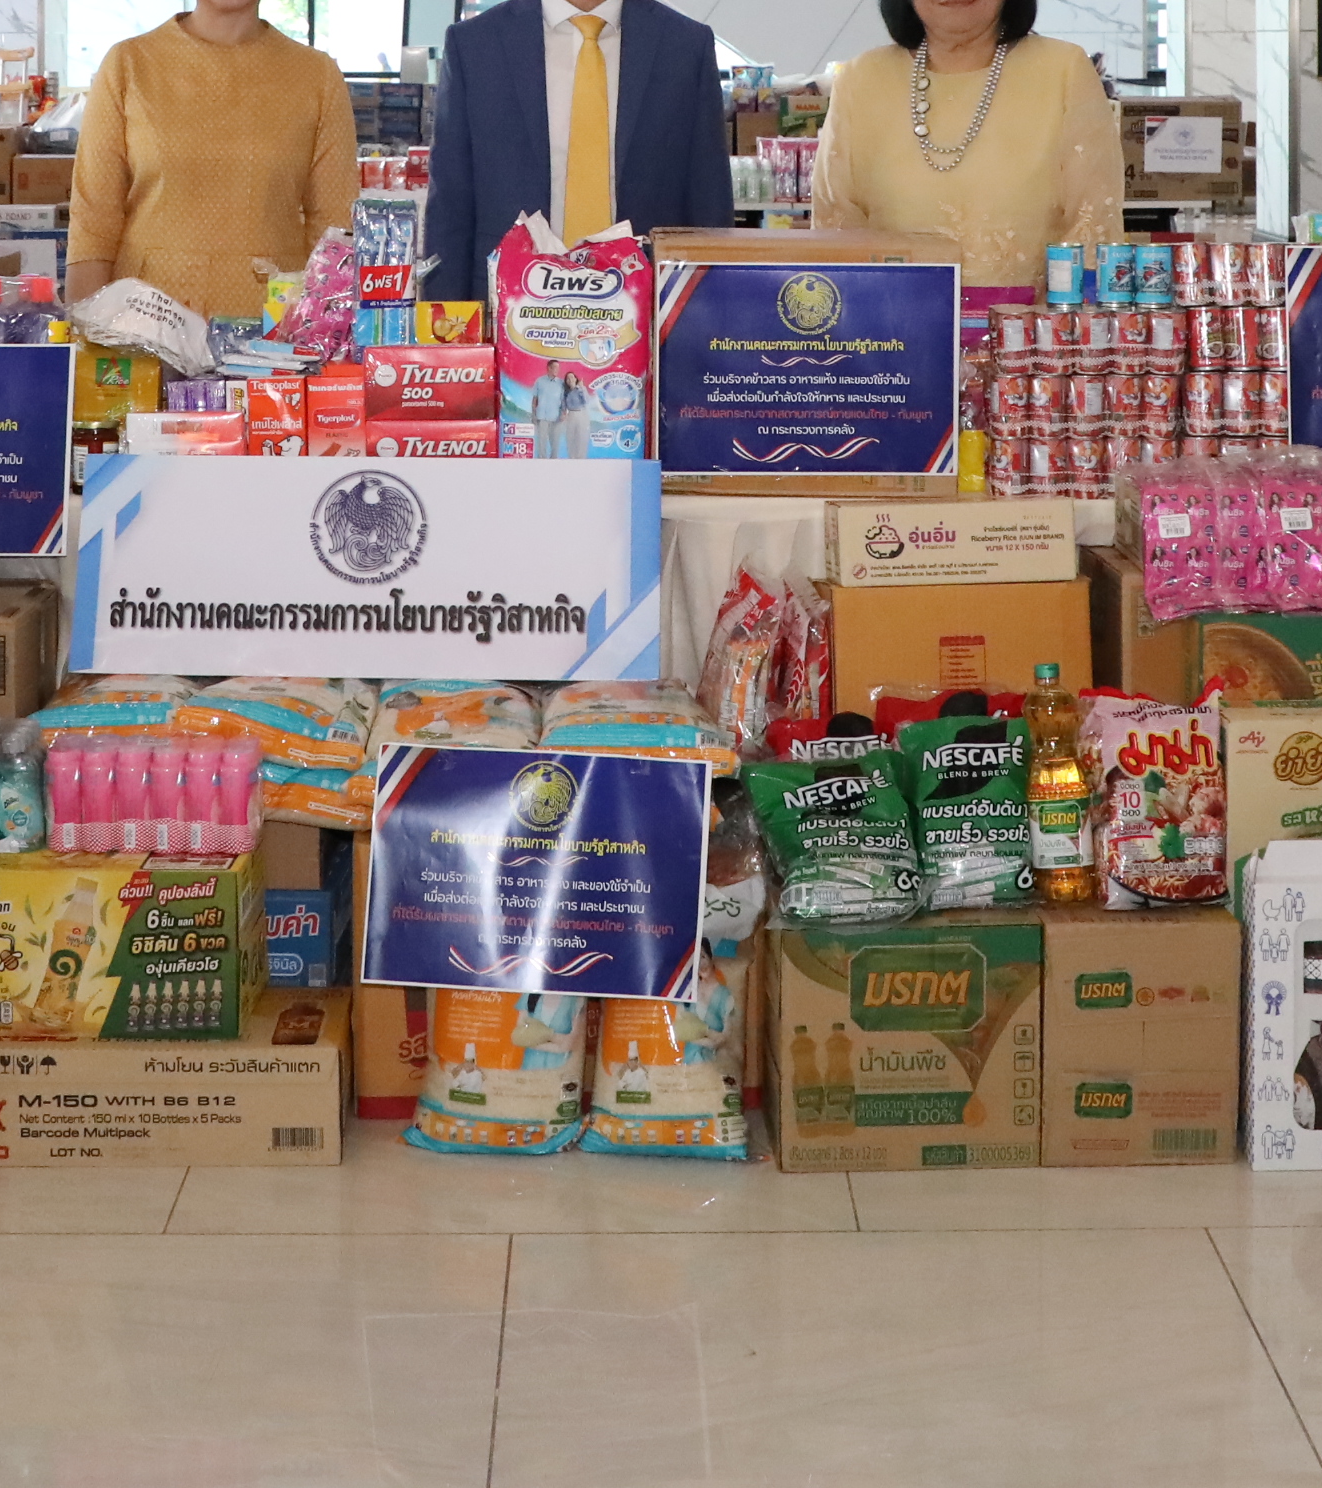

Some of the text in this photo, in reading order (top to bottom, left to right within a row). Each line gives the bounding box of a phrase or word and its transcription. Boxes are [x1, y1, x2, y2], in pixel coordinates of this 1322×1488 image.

[151, 291, 173, 307] Thai
[709, 335, 905, 354] สำนักงานคณะกรรมการนโยบายรัฐวิสาหกิจ
[401, 364, 486, 386] TYLENOL
[703, 372, 910, 386] ร่วมบริจาคข้าวสาร อาหารแห้ง และของใช้จำเป็น
[401, 387, 433, 400] 500
[707, 390, 906, 404] เพื่อส่งต่อเป็นกำลังใจให้ทหาร และประชาชน
[316, 413, 356, 424] Tigerplast
[771, 423, 855, 436] กระทรวงการคลัง
[402, 437, 489, 458] TYLENOL
[1022, 543, 1034, 551] 150
[109, 588, 587, 644] สำนักงานคณะกรรมการนโยบายรัฐวิสาหกิจ
[922, 736, 1025, 772] NESCAFÉ
[938, 768, 1010, 780] BLEND BREW
[783, 769, 893, 810] NESCAFÉ
[1119, 791, 1142, 809] 10
[1041, 811, 1077, 826] มรกต
[146, 909, 160, 929] 6
[183, 935, 196, 952] 6
[863, 968, 973, 1008] มรกต
[1080, 980, 1127, 1000] มรกต
[144, 1054, 322, 1075] ห้ามโยน ระวังสินค้าแตก
[859, 1046, 947, 1075] น้ำมันพืช
[17, 1094, 237, 1110] M-150 WITH B6 B12
[1079, 1091, 1128, 1109] มรกต
[19, 1113, 242, 1125] Net Content ml Bottles Packs
[907, 1107, 957, 1124] 100%
[20, 1128, 152, 1141] Barcode Multipack
[50, 1147, 104, 1159] LOT NO.
